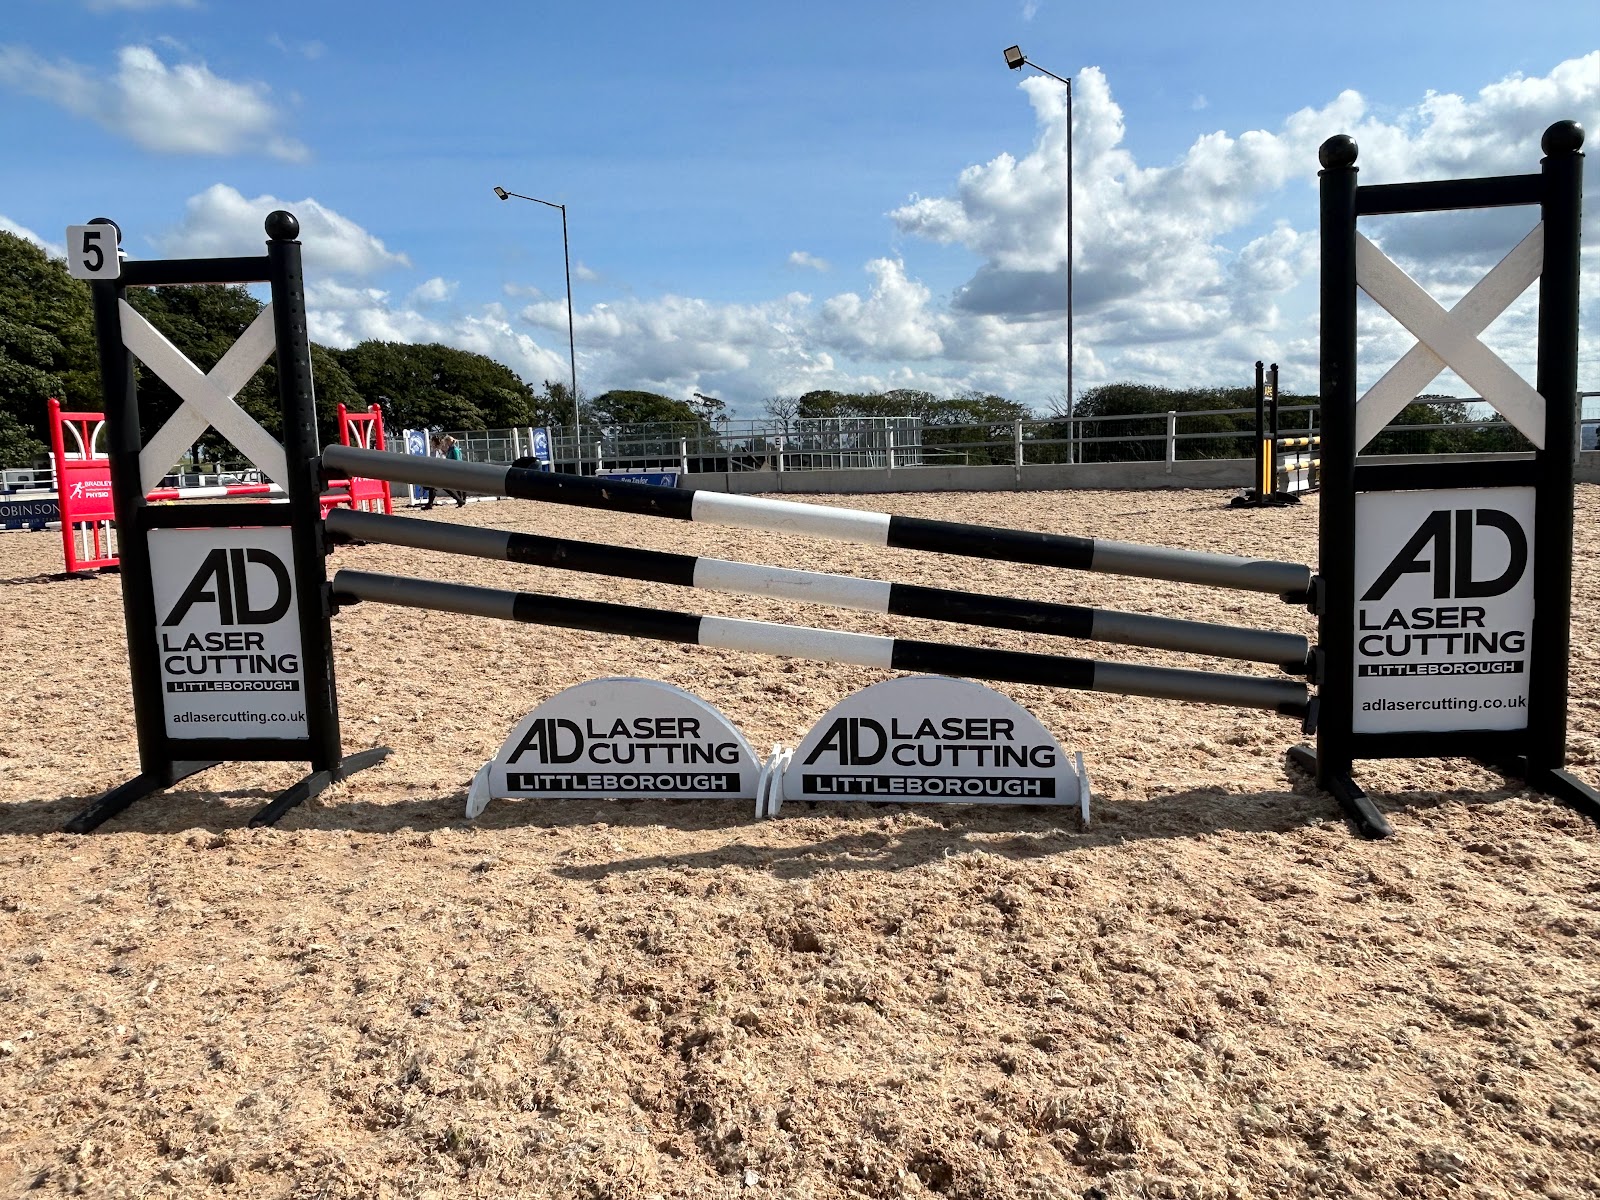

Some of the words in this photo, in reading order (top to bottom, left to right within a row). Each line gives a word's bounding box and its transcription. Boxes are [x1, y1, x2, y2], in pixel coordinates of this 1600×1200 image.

[83, 232, 104, 271] 5
[0, 503, 61, 517] OBINSON
[1360, 508, 1528, 601] AD
[161, 548, 292, 627] AD
[1359, 606, 1486, 631] LASER
[162, 632, 265, 652] LASER
[1358, 631, 1525, 656] CUTTING
[164, 654, 299, 675] CUTTING
[1367, 662, 1515, 676] LITTLEBOROUGH
[174, 681, 293, 692] LITTLEBOROUGH
[1362, 695, 1527, 712] adlasercutting.co.uk
[173, 710, 306, 724] adlasercutting.co.uk
[587, 717, 701, 739] LASER
[891, 717, 1015, 741] LASER
[506, 718, 585, 764] AD
[802, 717, 888, 765] AD
[588, 742, 740, 765] CUTTING
[891, 744, 1056, 768] CUTTING
[519, 775, 727, 790] LITTLEBOROUGH
[816, 776, 1041, 795] LITTLEBOROUGH
